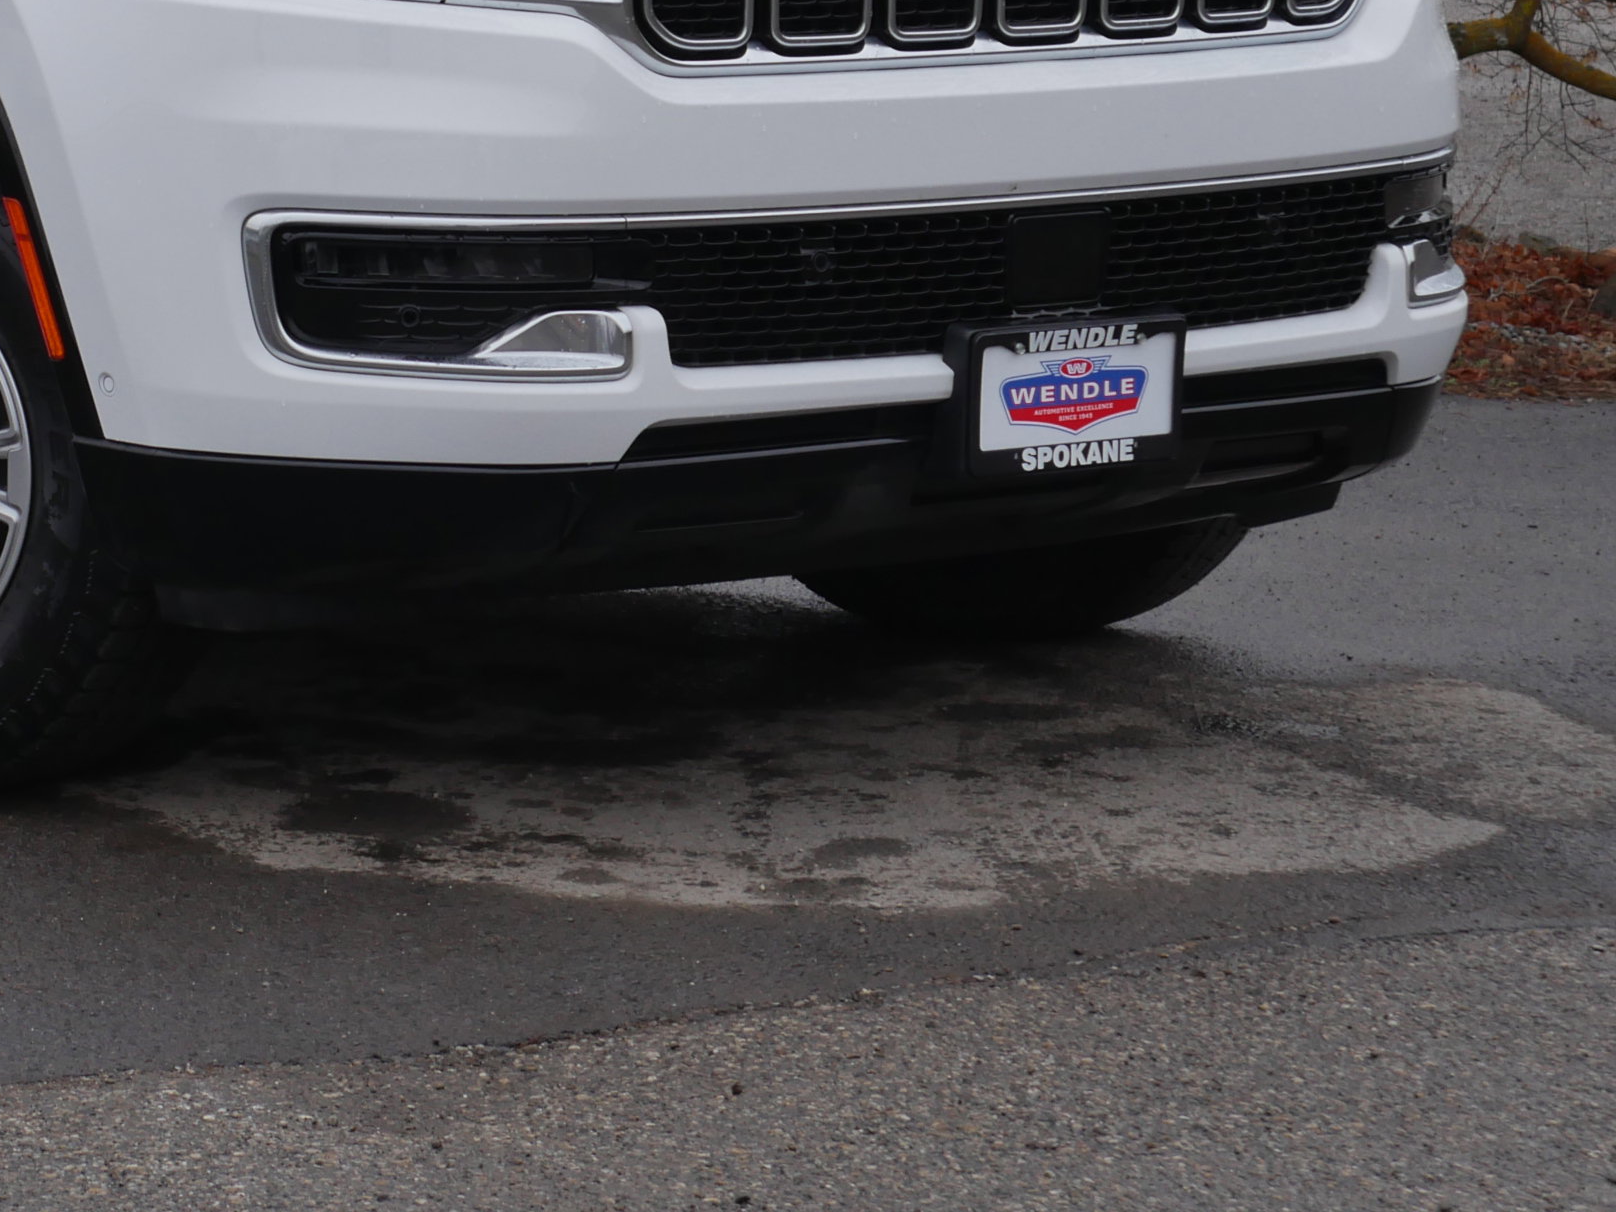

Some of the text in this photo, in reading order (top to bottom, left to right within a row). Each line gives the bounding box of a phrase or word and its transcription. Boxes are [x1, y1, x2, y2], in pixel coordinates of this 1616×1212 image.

[1029, 324, 1138, 353] WENDLE
[1066, 362, 1087, 375] W
[1011, 378, 1135, 405] WENDLE
[1034, 402, 1114, 416] AUTOMOTIVE EXCELLENCE
[1058, 414, 1077, 422] SINCE
[1021, 438, 1134, 472] SPOKANE
